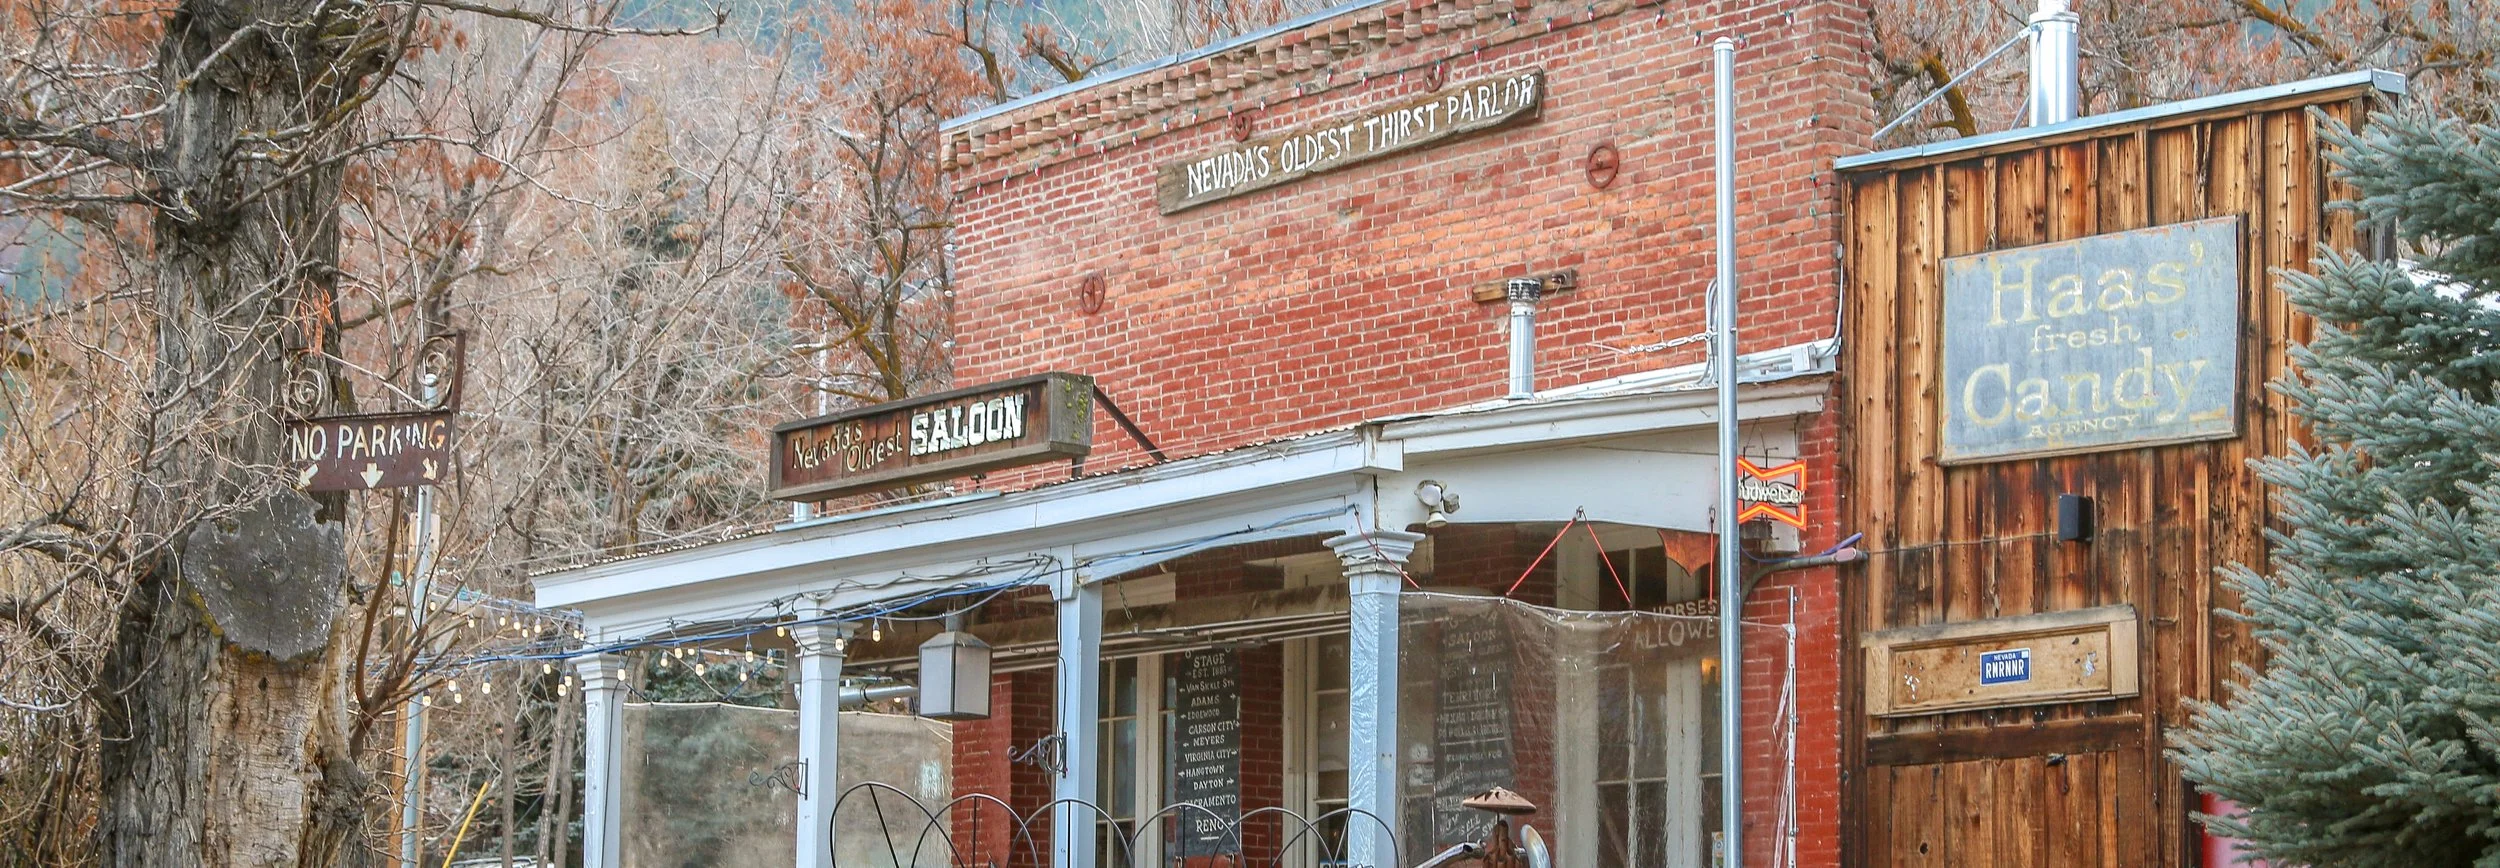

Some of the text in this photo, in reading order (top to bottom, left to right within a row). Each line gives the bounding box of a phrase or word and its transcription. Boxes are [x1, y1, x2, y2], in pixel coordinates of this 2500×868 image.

[1187, 74, 1535, 197] NEVADA'S OLDEST THIRST PARLOR
[2030, 316, 2141, 352] fresh
[1963, 347, 2208, 427] Candy
[909, 393, 1028, 456] SALOON
[2026, 414, 2141, 439] AGENCY
[291, 424, 327, 463] NO
[337, 419, 446, 461] PARKING
[846, 422, 904, 472] Oldest
[1653, 600, 1719, 622] HORSES
[1448, 628, 1496, 647] SALOON
[1634, 617, 1716, 649] ALLOWE
[1193, 653, 1225, 668] STAGE
[1993, 652, 2016, 661] NEVADA
[1191, 695, 1220, 707] ADAMS
[1188, 720, 1236, 735] CARSON CITY
[1193, 734, 1225, 747] MEYERS
[1185, 749, 1231, 763] VIRGINIA CITY
[1185, 765, 1225, 778] HANGTOWN
[1193, 778, 1224, 790] DAYTON
[1196, 818, 1224, 834] RENO
